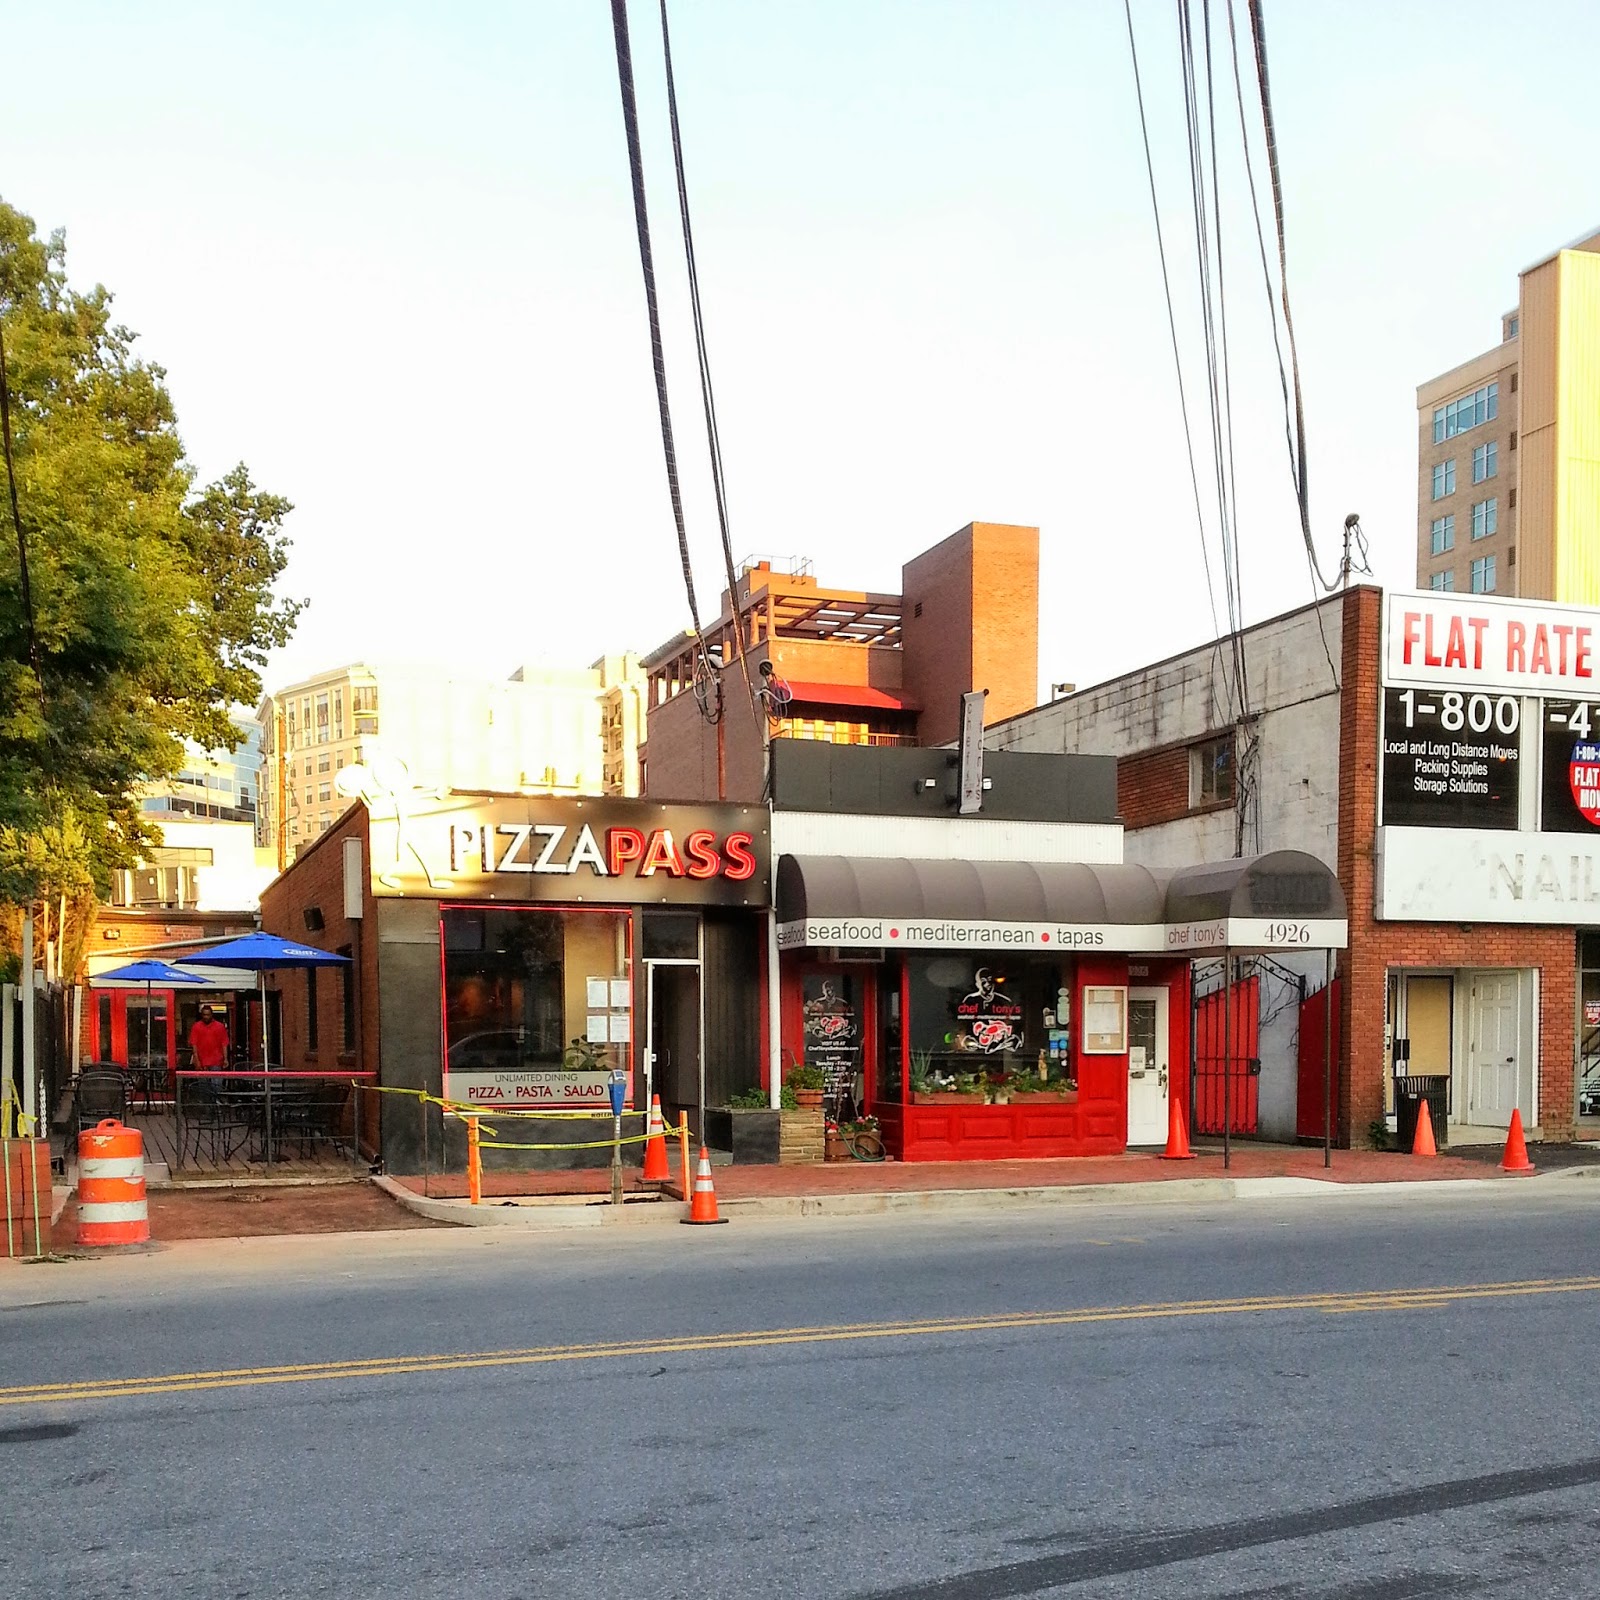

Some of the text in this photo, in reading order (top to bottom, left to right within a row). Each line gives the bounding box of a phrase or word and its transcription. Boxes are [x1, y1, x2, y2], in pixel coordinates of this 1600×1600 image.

[1403, 612, 1592, 678] FLAT RATE
[1399, 689, 1520, 735] 1-800
[1384, 739, 1518, 760] Local and Long Distance Moves
[1414, 758, 1488, 776] Packing Supplies
[1574, 766, 1600, 787] FLAT
[1413, 776, 1488, 795] Storage Solutions
[808, 922, 1104, 948] seafood mediterranean tapas
[1168, 924, 1225, 945] chef tony's
[1264, 923, 1310, 943] 4926
[957, 1003, 1021, 1014] chef tony's
[495, 1073, 578, 1083] UNLIMITED DINING
[468, 1085, 604, 1099] PIZZA PASTA SALAD
